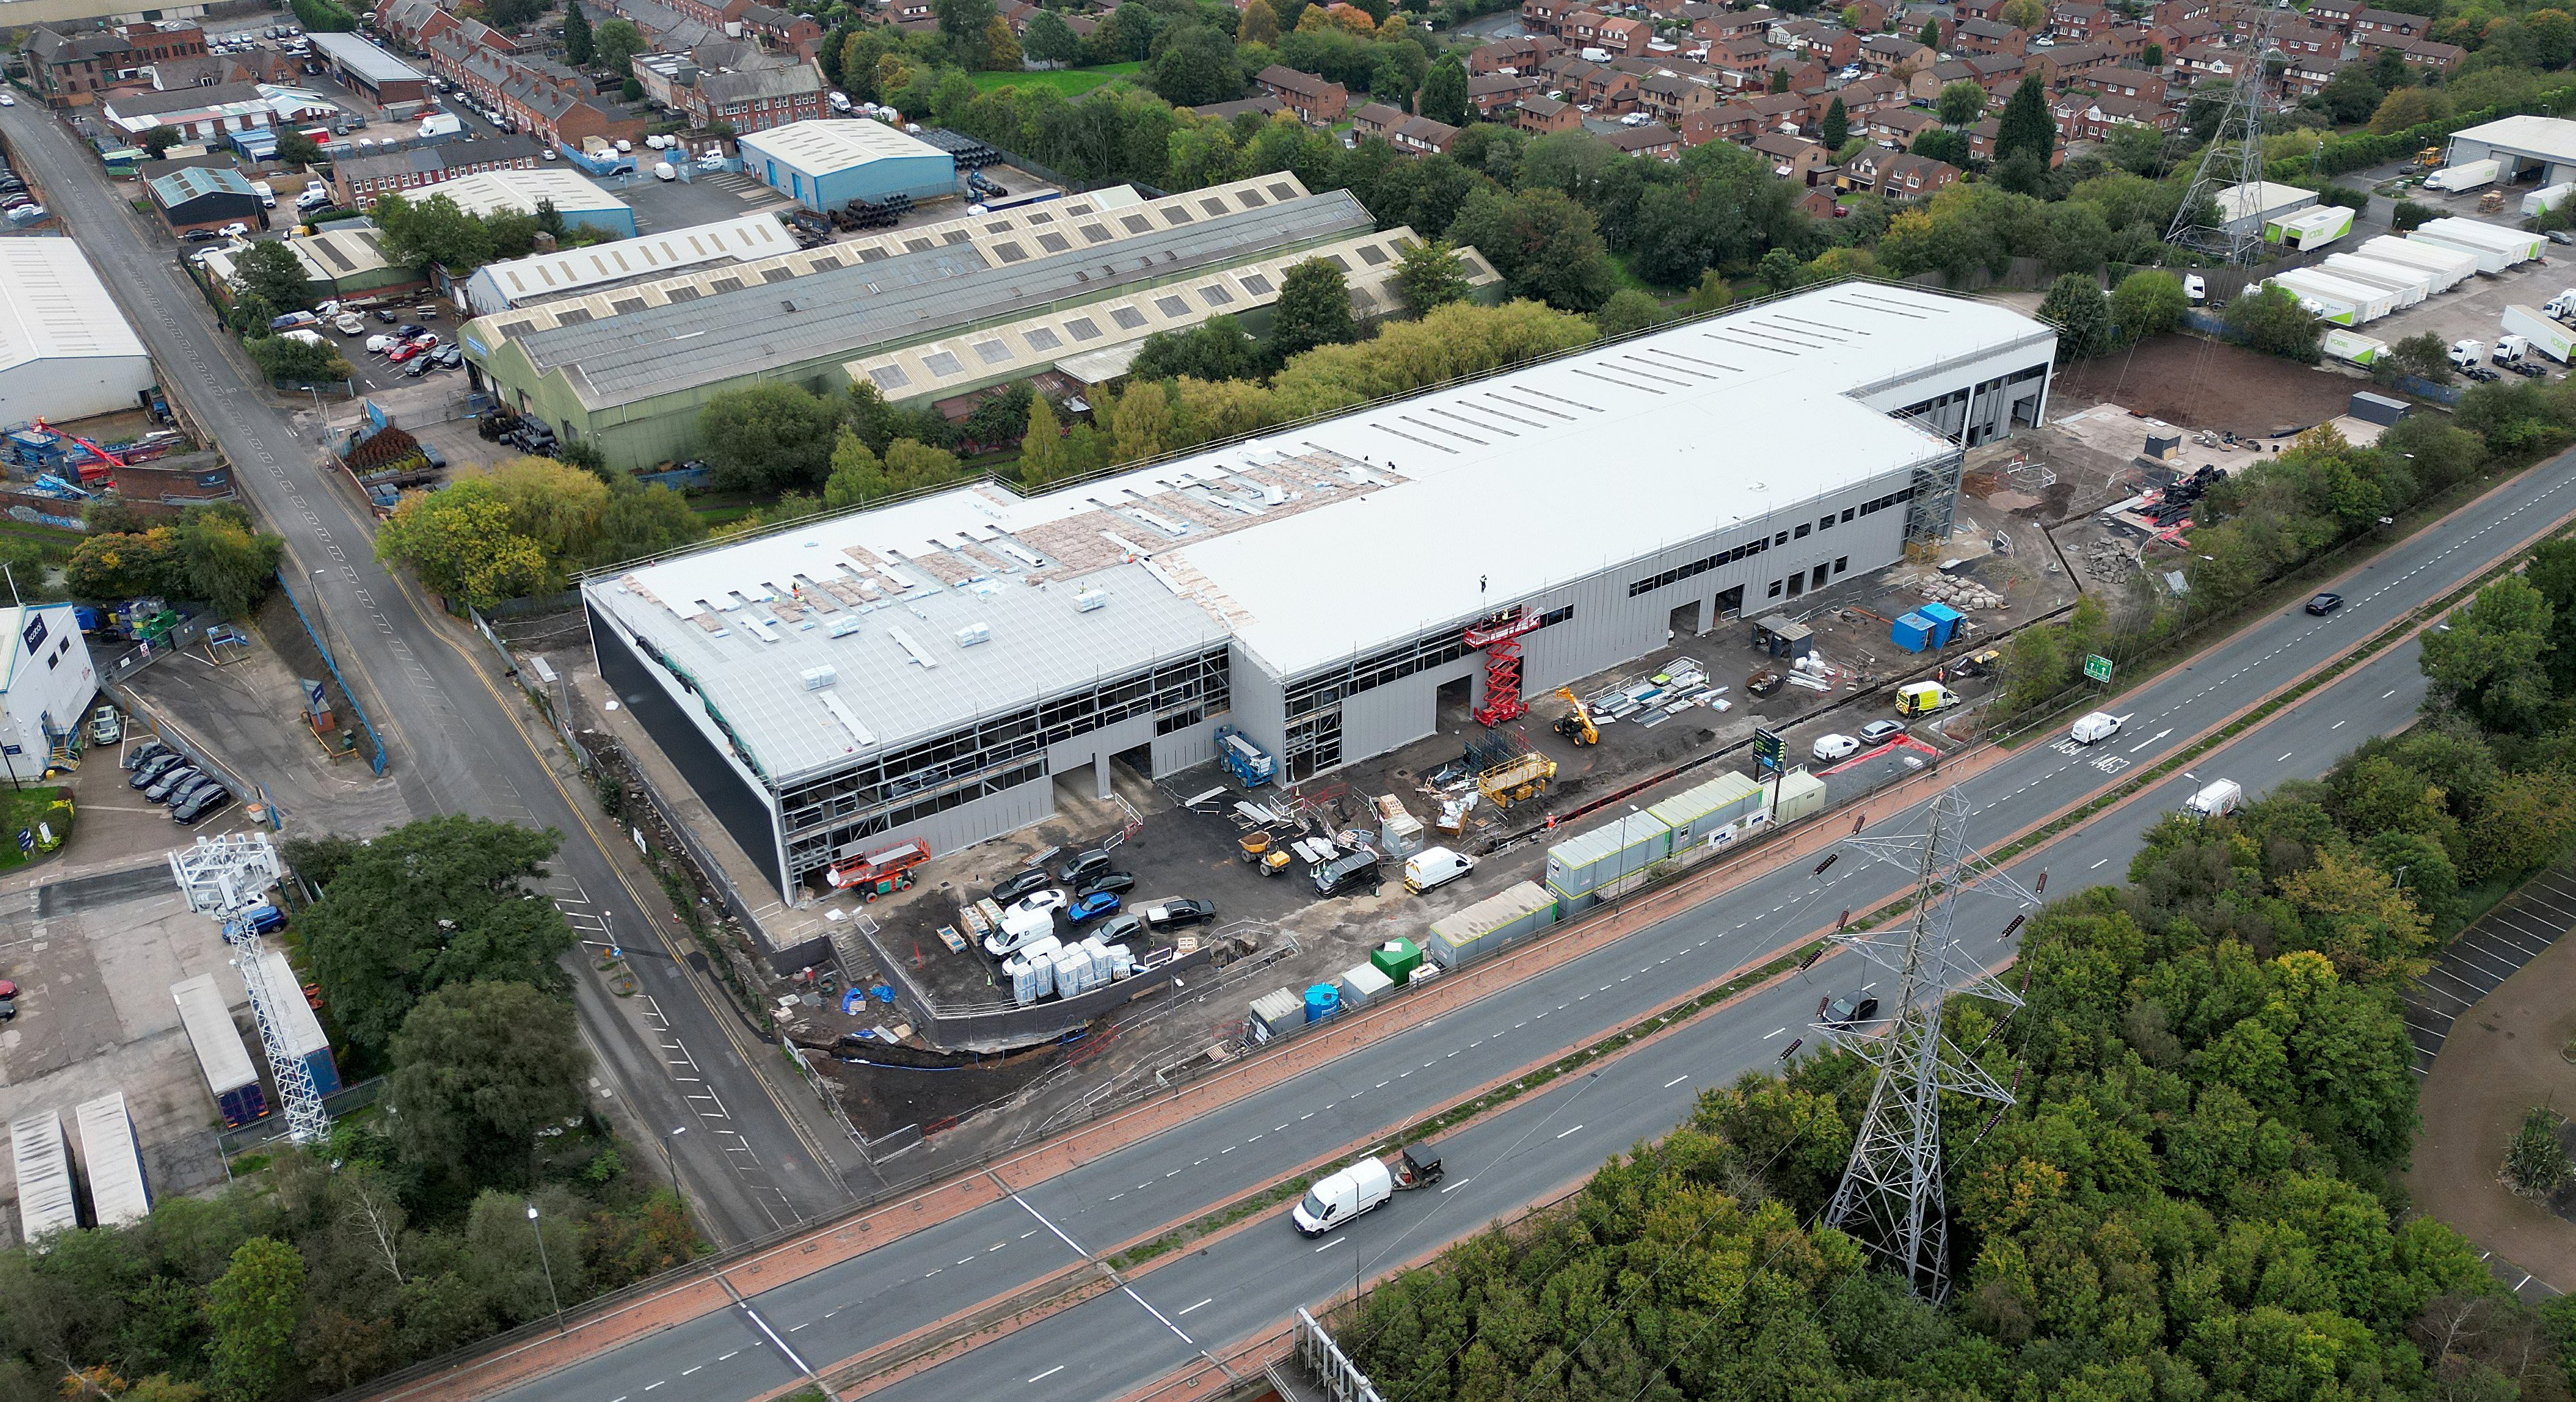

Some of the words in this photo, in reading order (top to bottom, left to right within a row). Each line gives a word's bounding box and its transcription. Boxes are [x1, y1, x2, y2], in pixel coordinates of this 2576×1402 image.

[2330, 338, 2349, 348] YODEL
[2049, 738, 2089, 757] A454
[2088, 753, 2130, 774] A463
